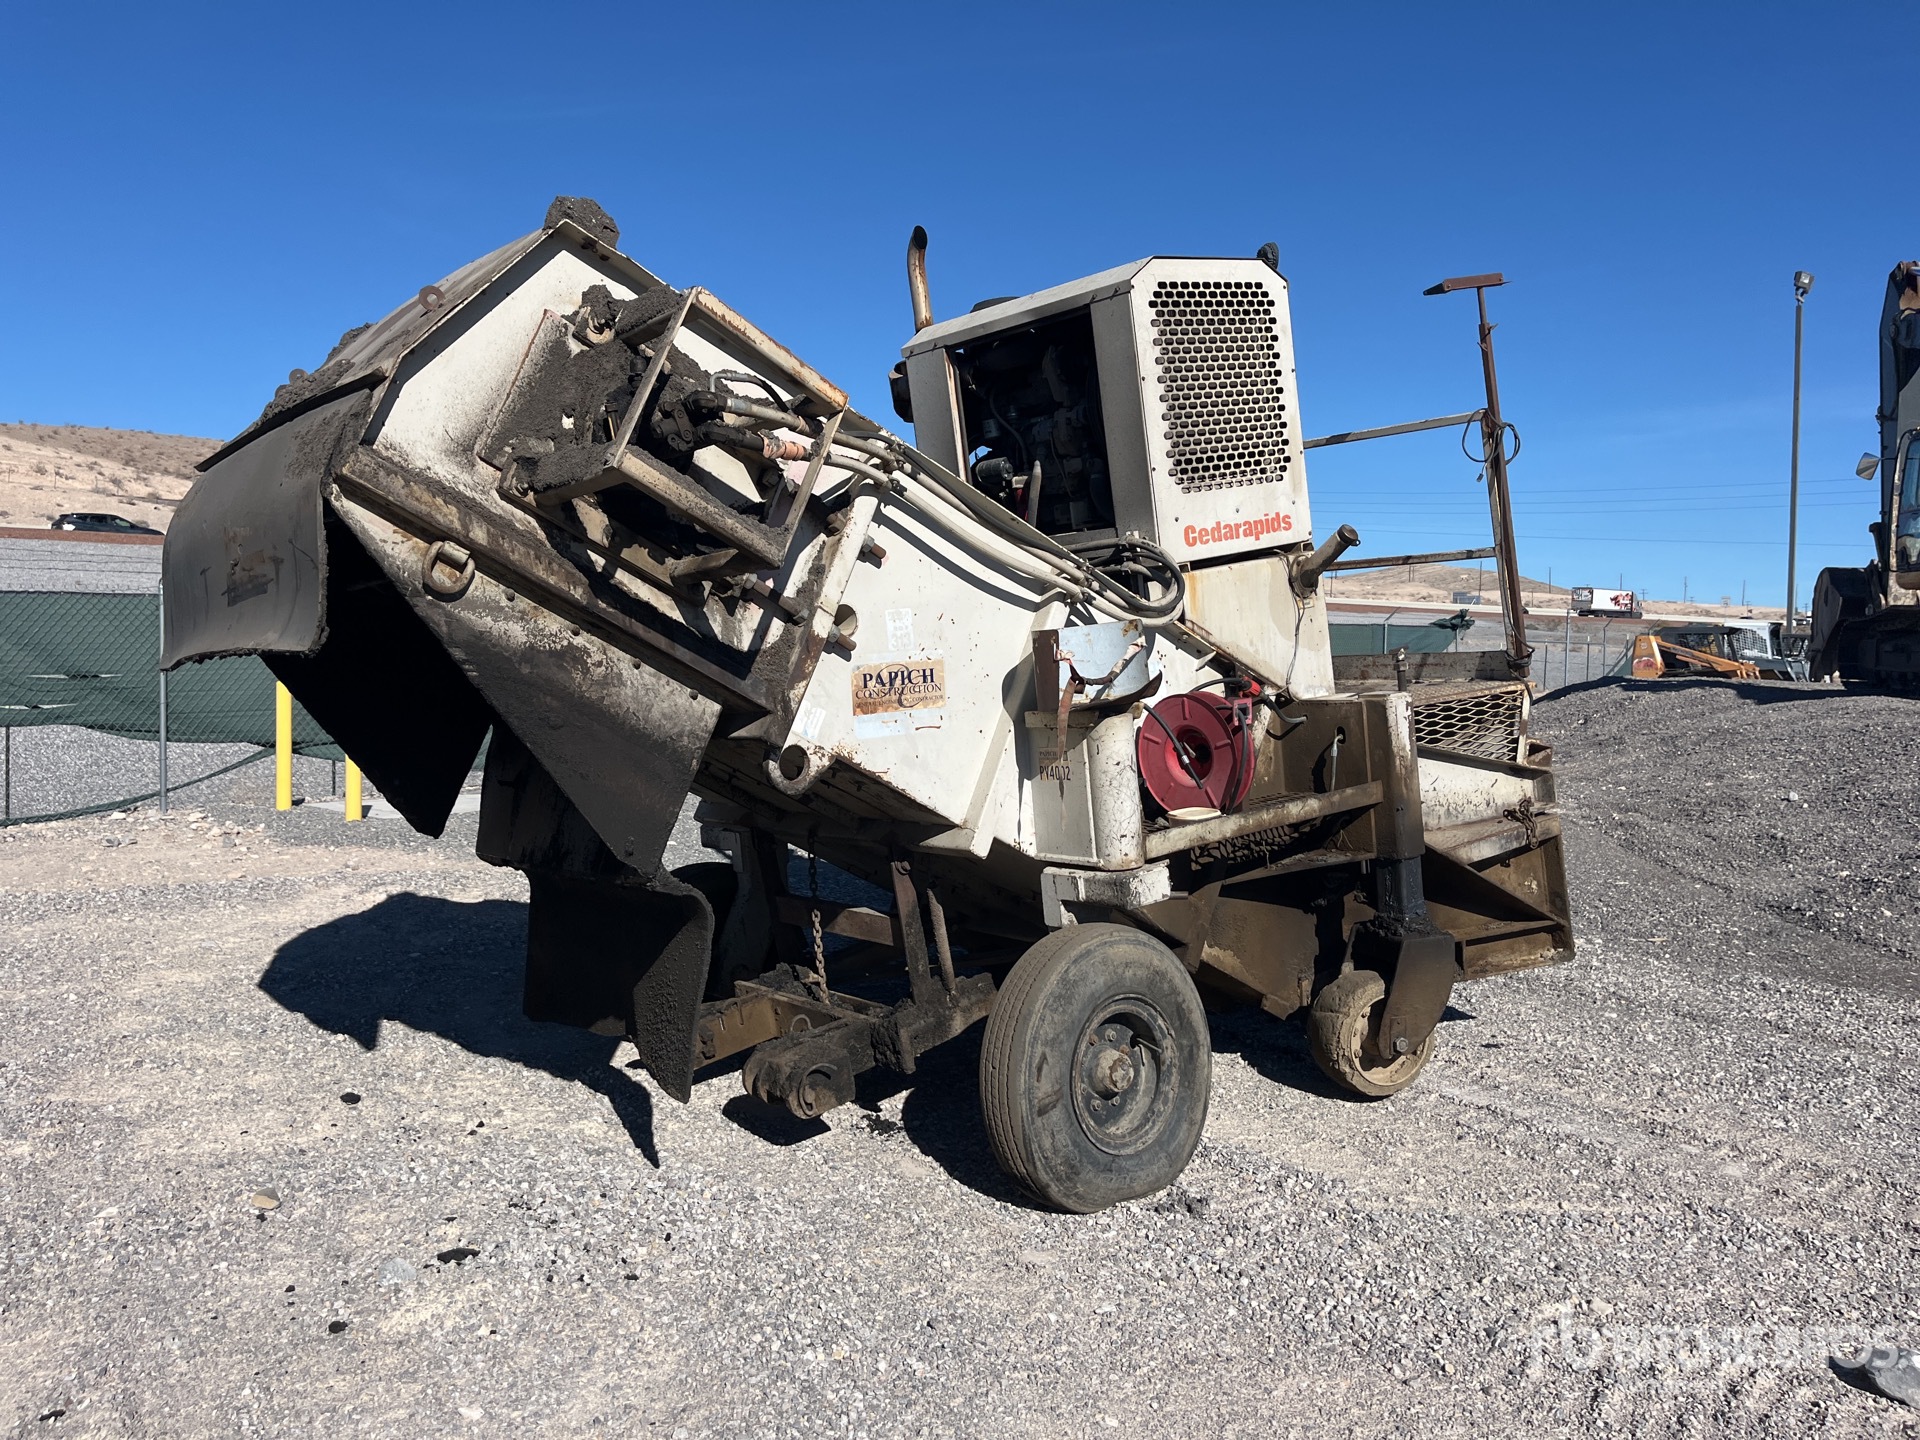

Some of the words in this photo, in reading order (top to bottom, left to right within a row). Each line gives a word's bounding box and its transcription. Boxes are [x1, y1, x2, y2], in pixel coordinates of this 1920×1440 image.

[1184, 511, 1292, 547] Cedarapids
[862, 668, 935, 689] PAPICH
[855, 683, 942, 700] CONSTRUCTION
